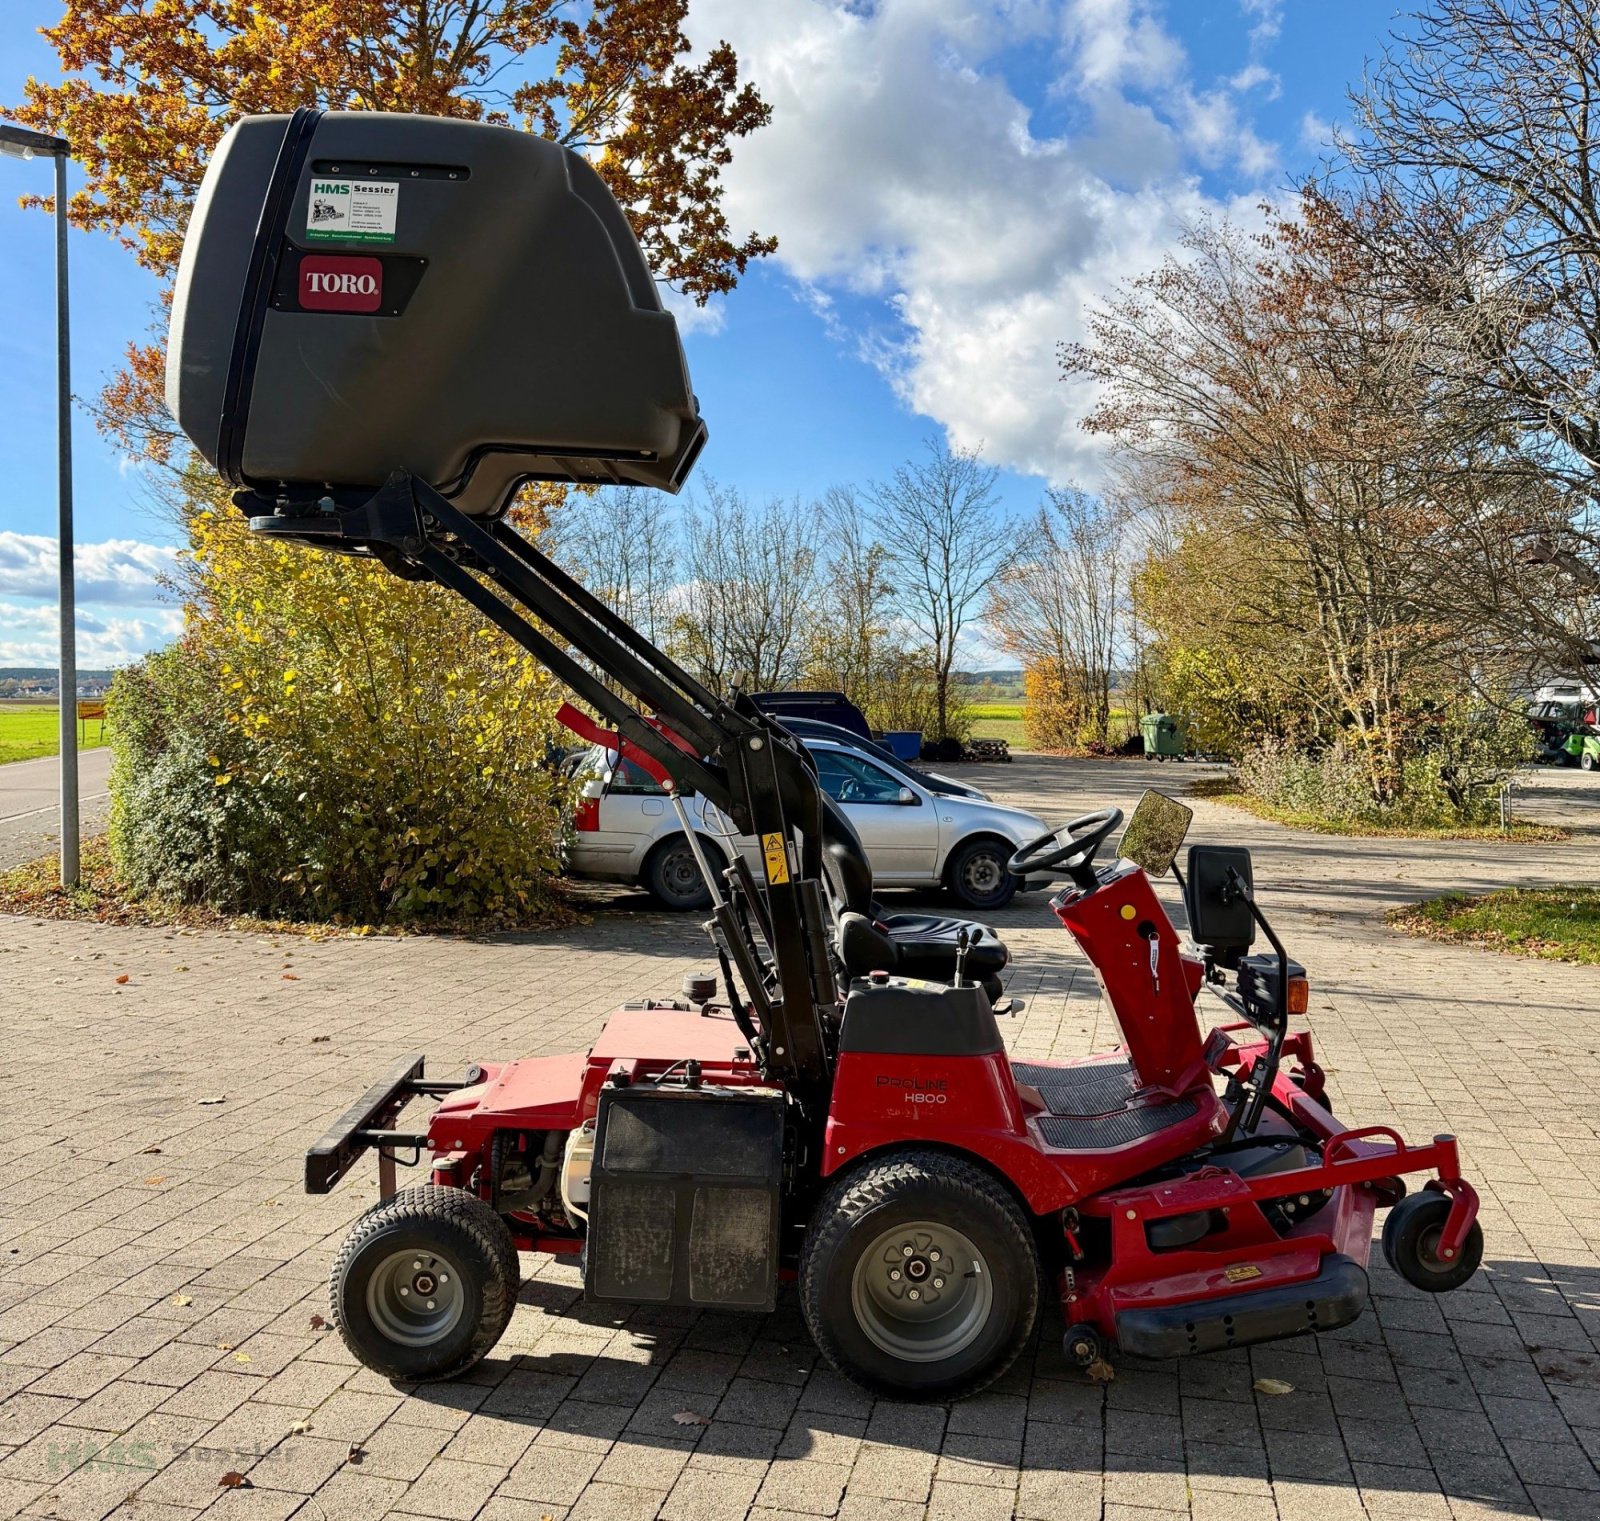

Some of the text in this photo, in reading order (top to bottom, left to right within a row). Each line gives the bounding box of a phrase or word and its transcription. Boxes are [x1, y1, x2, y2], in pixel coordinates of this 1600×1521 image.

[314, 183, 395, 195] HMS Sessler
[306, 272, 376, 295] TORO
[904, 1092, 947, 1104] H800
